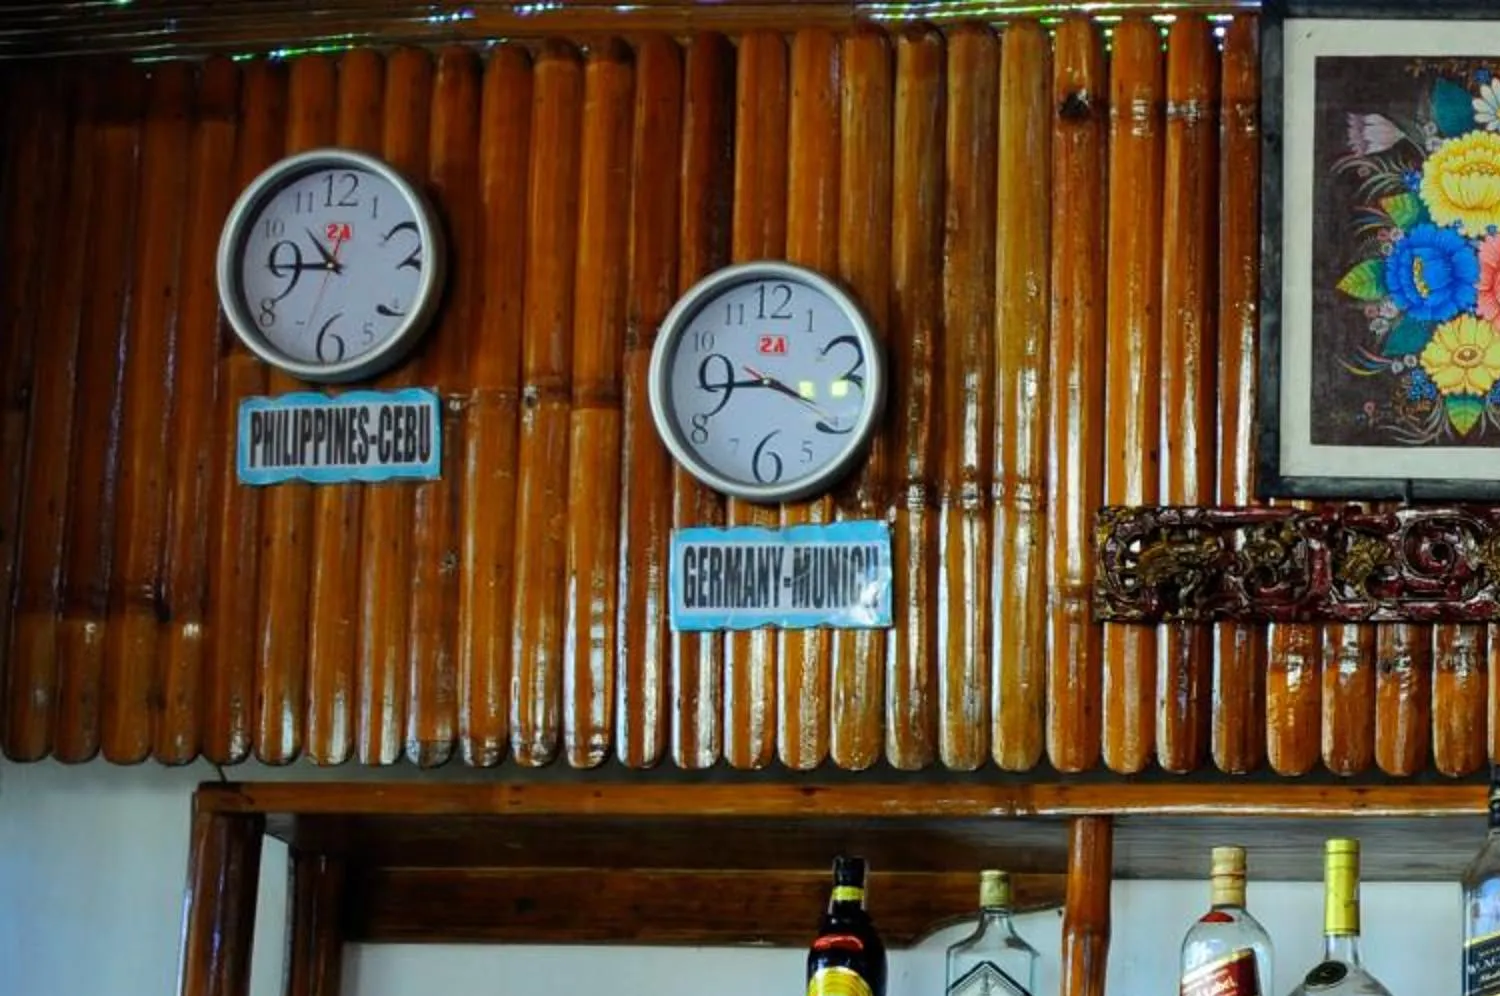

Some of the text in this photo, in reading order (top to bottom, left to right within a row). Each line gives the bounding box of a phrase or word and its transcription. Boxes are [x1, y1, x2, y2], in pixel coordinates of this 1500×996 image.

[295, 191, 314, 214] 11
[323, 174, 359, 208] 12
[371, 196, 378, 219] 1
[264, 219, 285, 239] 10
[268, 240, 303, 304] 9
[259, 300, 276, 327] 8
[725, 303, 745, 326] 11
[756, 284, 793, 320] 12
[362, 323, 375, 345] 5
[806, 308, 815, 333] 1
[315, 312, 345, 362] 6
[692, 330, 715, 353] 10
[699, 352, 735, 418] 9
[251, 404, 431, 467] PHILIPPINES-CEBU
[690, 413, 709, 445] 8
[752, 430, 783, 484] 6
[800, 440, 814, 464] 5
